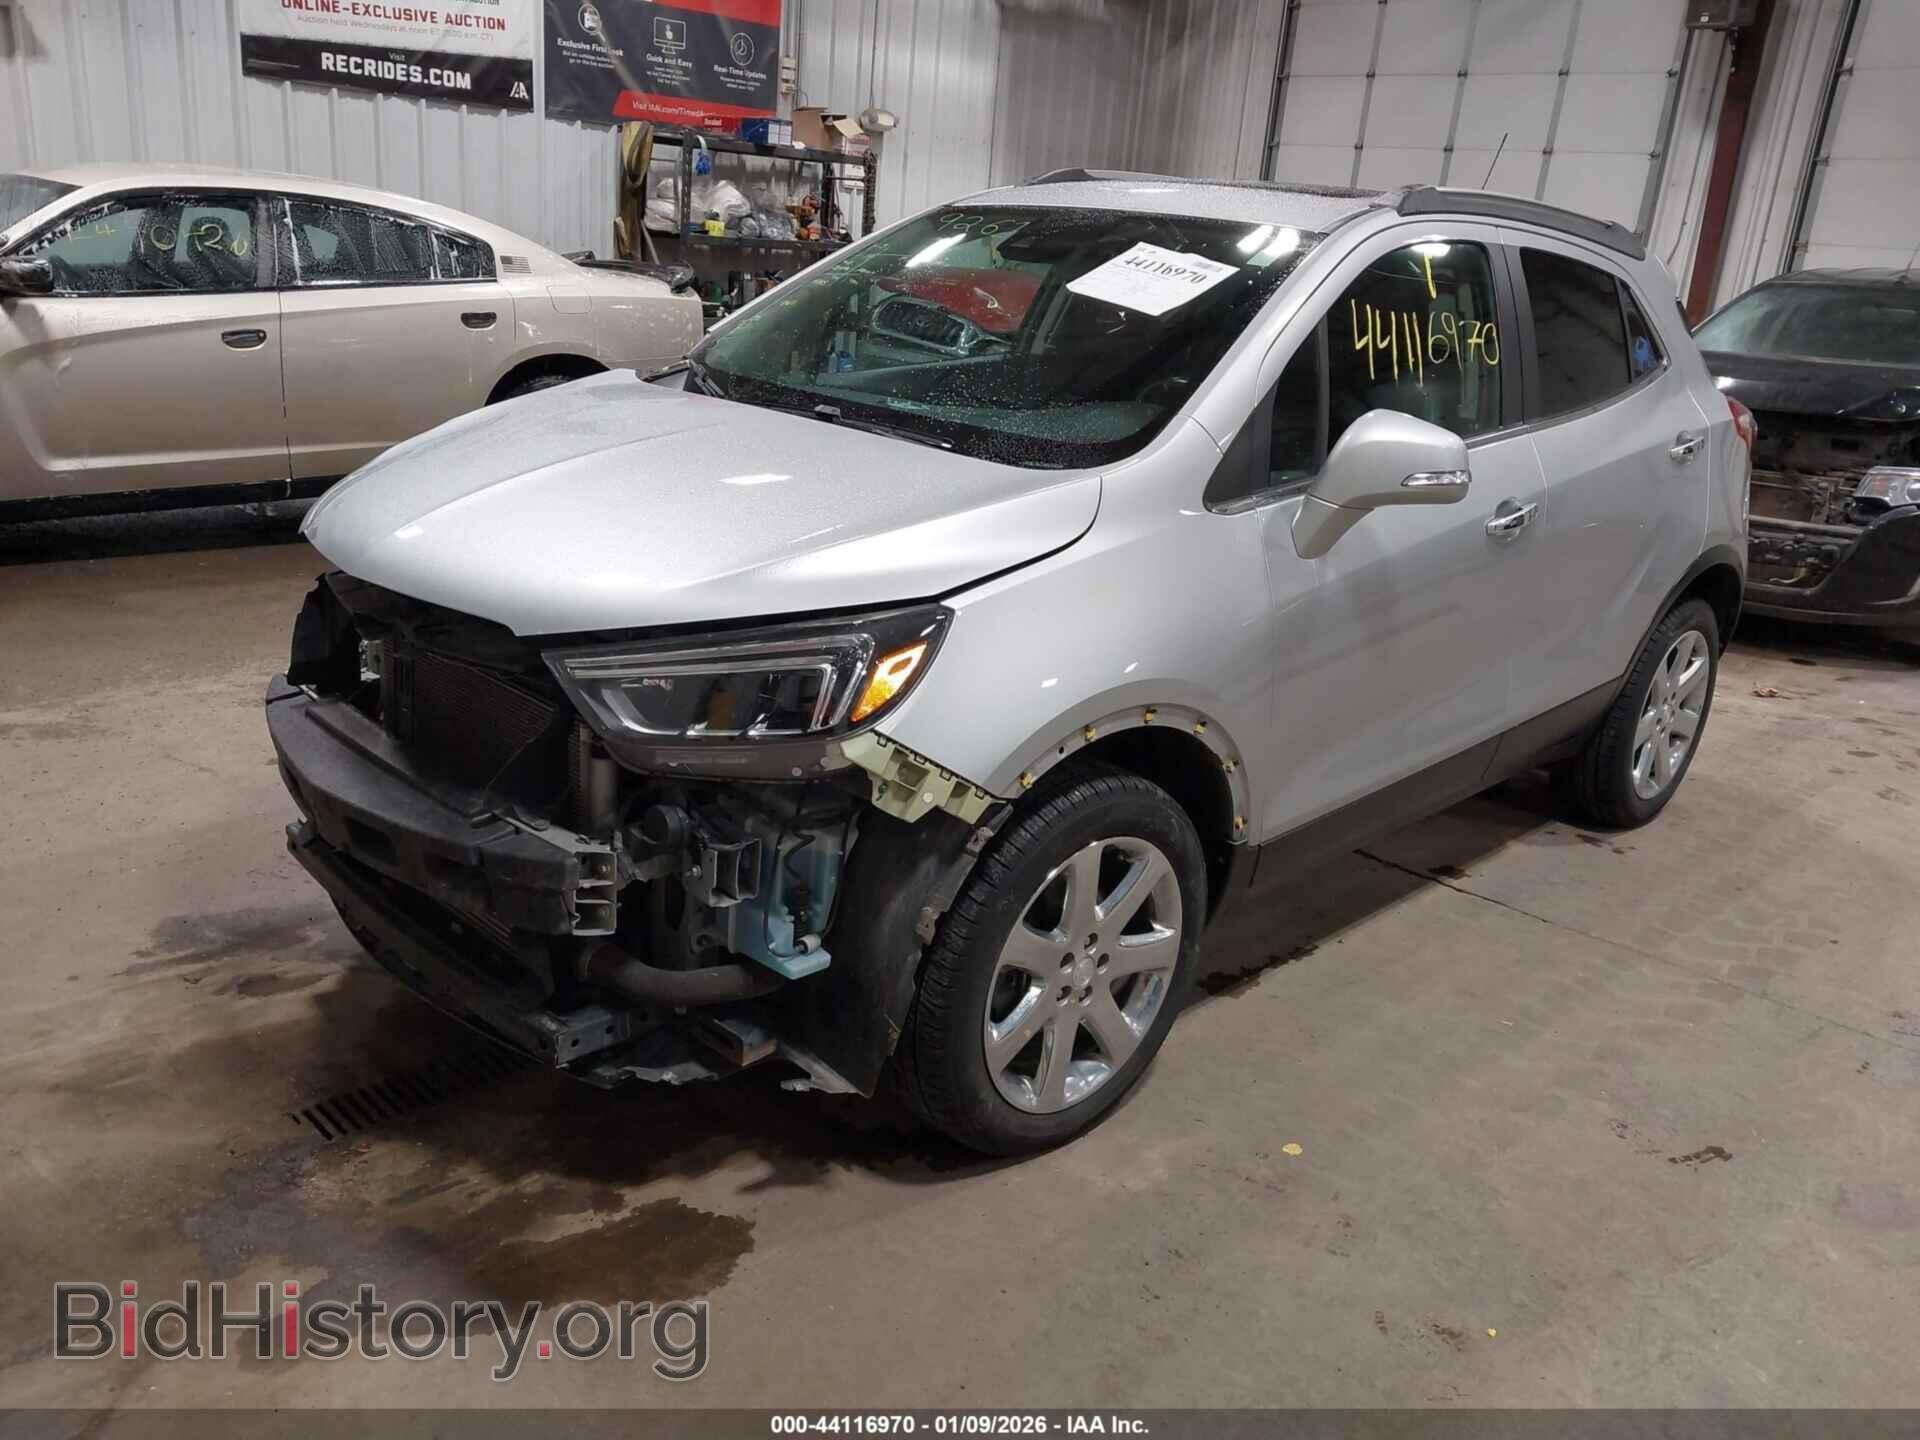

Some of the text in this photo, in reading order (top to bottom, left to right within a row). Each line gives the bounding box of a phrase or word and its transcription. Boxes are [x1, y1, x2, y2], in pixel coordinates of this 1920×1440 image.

[281, 0, 505, 31] ONLINE-EXCLUSIVE AUCTION
[321, 51, 472, 89] RECRIDES.COM
[388, 51, 406, 61] Visit
[646, 53, 693, 69] Quick and Easy
[1124, 256, 1208, 284] 44116970
[1351, 298, 1500, 388] 44116970
